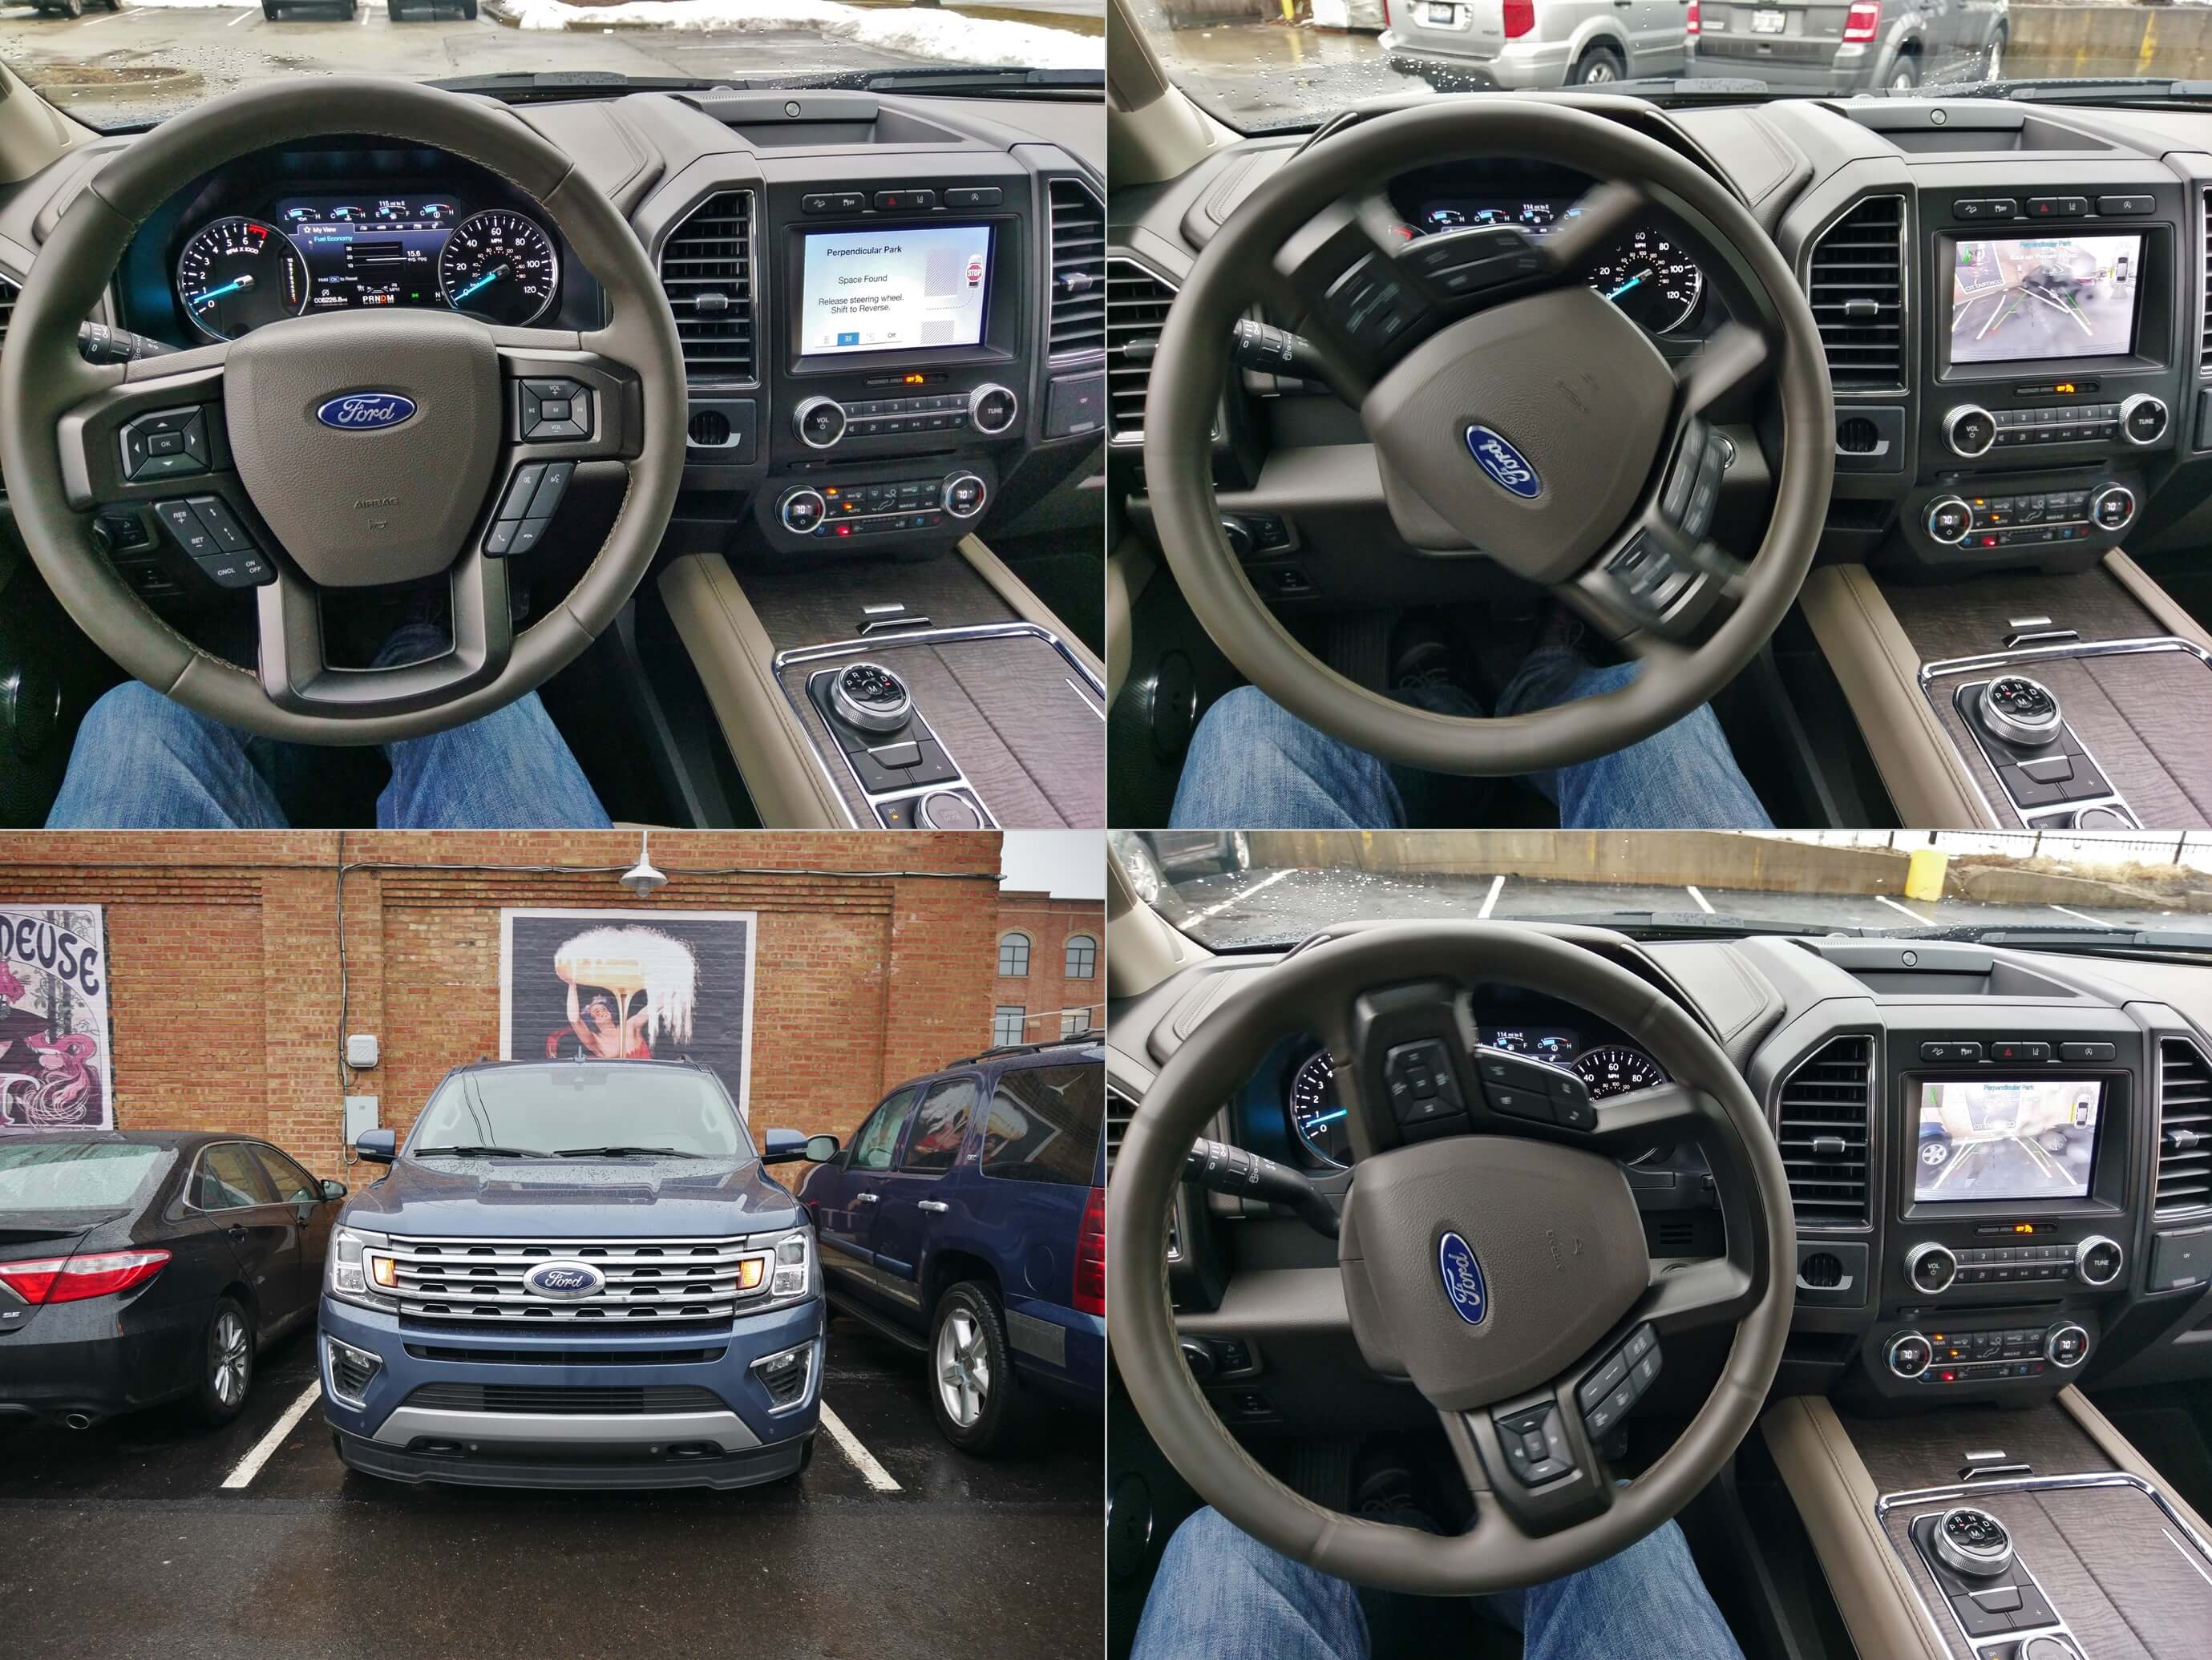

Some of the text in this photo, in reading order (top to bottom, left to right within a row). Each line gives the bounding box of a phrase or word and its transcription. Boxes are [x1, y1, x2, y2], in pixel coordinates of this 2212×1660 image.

[226, 239, 233, 247] 5
[212, 246, 219, 254] 4
[225, 248, 239, 256] RPM
[827, 247, 882, 256] Perpendicular
[204, 257, 210, 265] 3
[1599, 267, 1610, 275] 20
[200, 272, 206, 280] 2
[839, 277, 862, 285] Space
[1667, 291, 1680, 299] 120
[819, 294, 904, 305] Release steering wheel.
[831, 305, 847, 313] Shift
[338, 398, 395, 423] Ford
[1479, 439, 1530, 484] Ford
[958, 491, 968, 499] 70
[354, 497, 398, 508] AIRBAG
[796, 506, 806, 514] 70
[192, 536, 204, 544] SET
[1608, 1063, 1619, 1071] 60
[1318, 1081, 1324, 1089] 3
[1313, 1095, 1319, 1103] 2
[1316, 1110, 1319, 1118] 1
[545, 1271, 583, 1286] Ford
[1447, 1252, 1480, 1306] Ford
[2062, 1341, 2070, 1349] 70
[1903, 1350, 1912, 1359] 70
